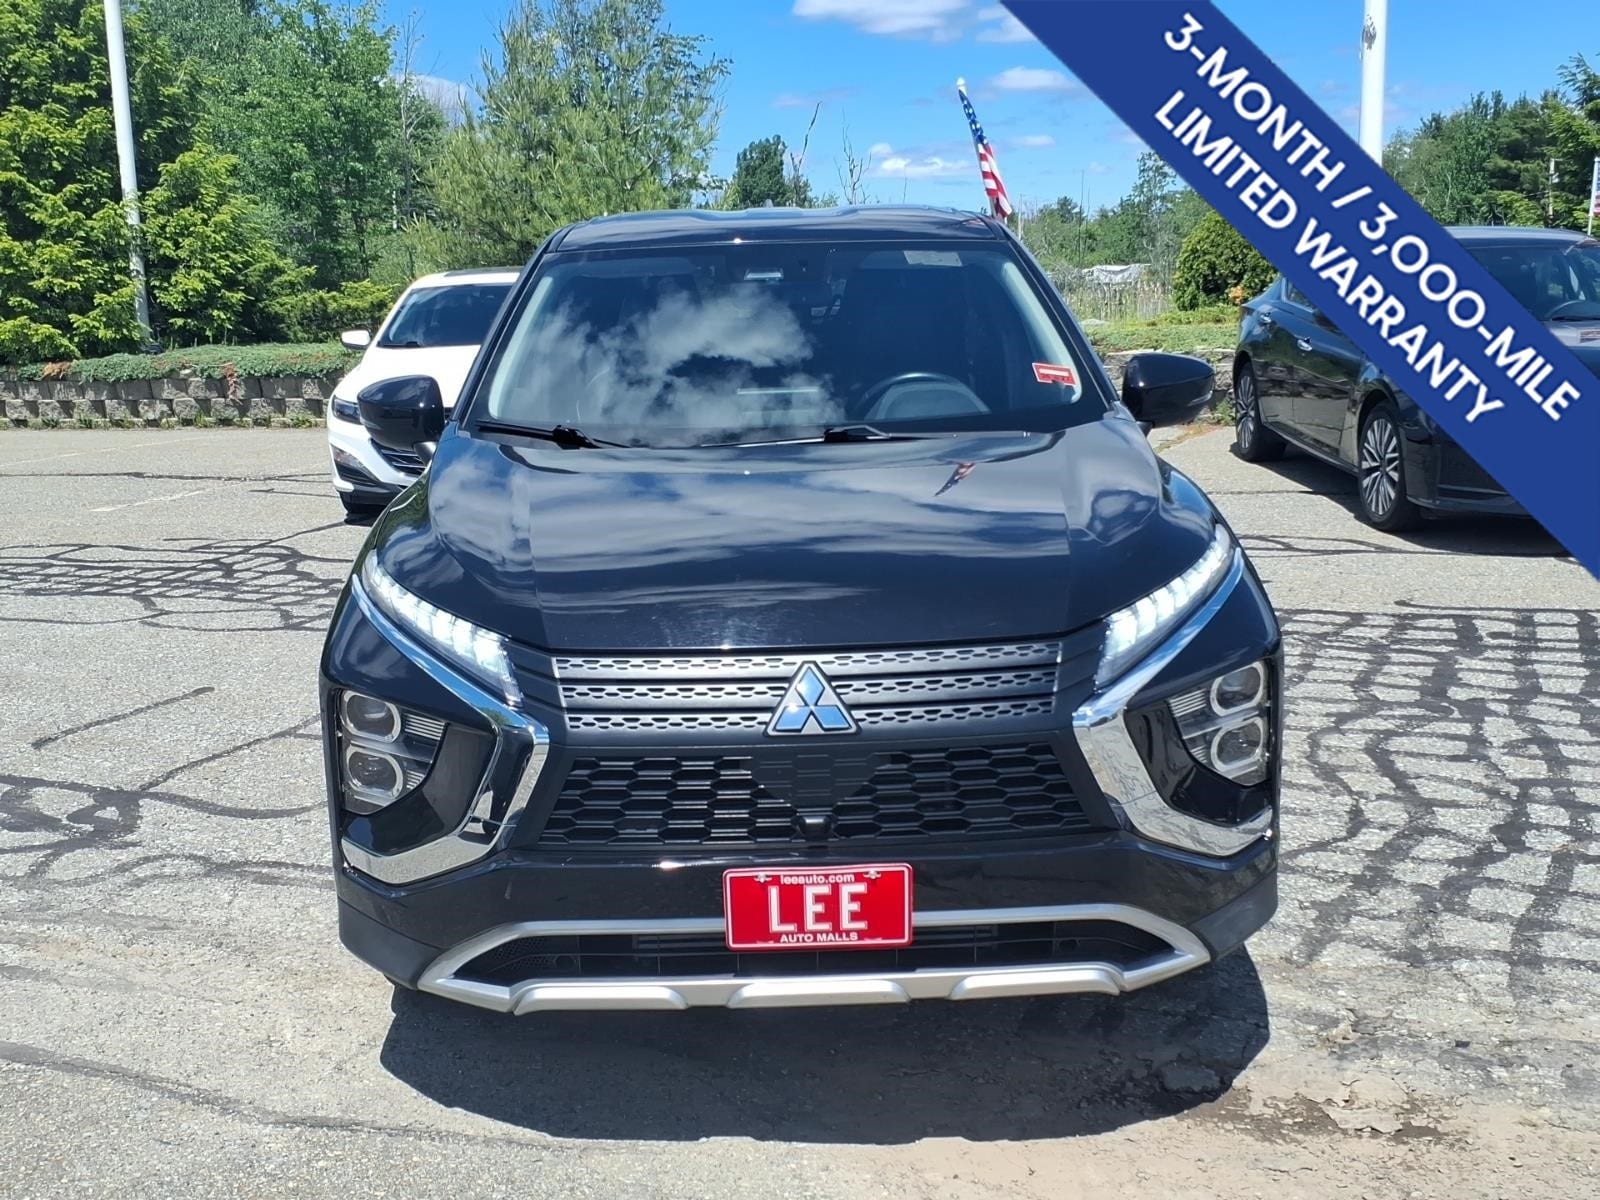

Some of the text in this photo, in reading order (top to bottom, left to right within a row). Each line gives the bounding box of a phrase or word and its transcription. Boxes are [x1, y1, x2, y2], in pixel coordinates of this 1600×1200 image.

[780, 874, 855, 885] leeauto.com
[768, 882, 868, 933] LEE
[780, 932, 859, 943] AUTO MALLS
